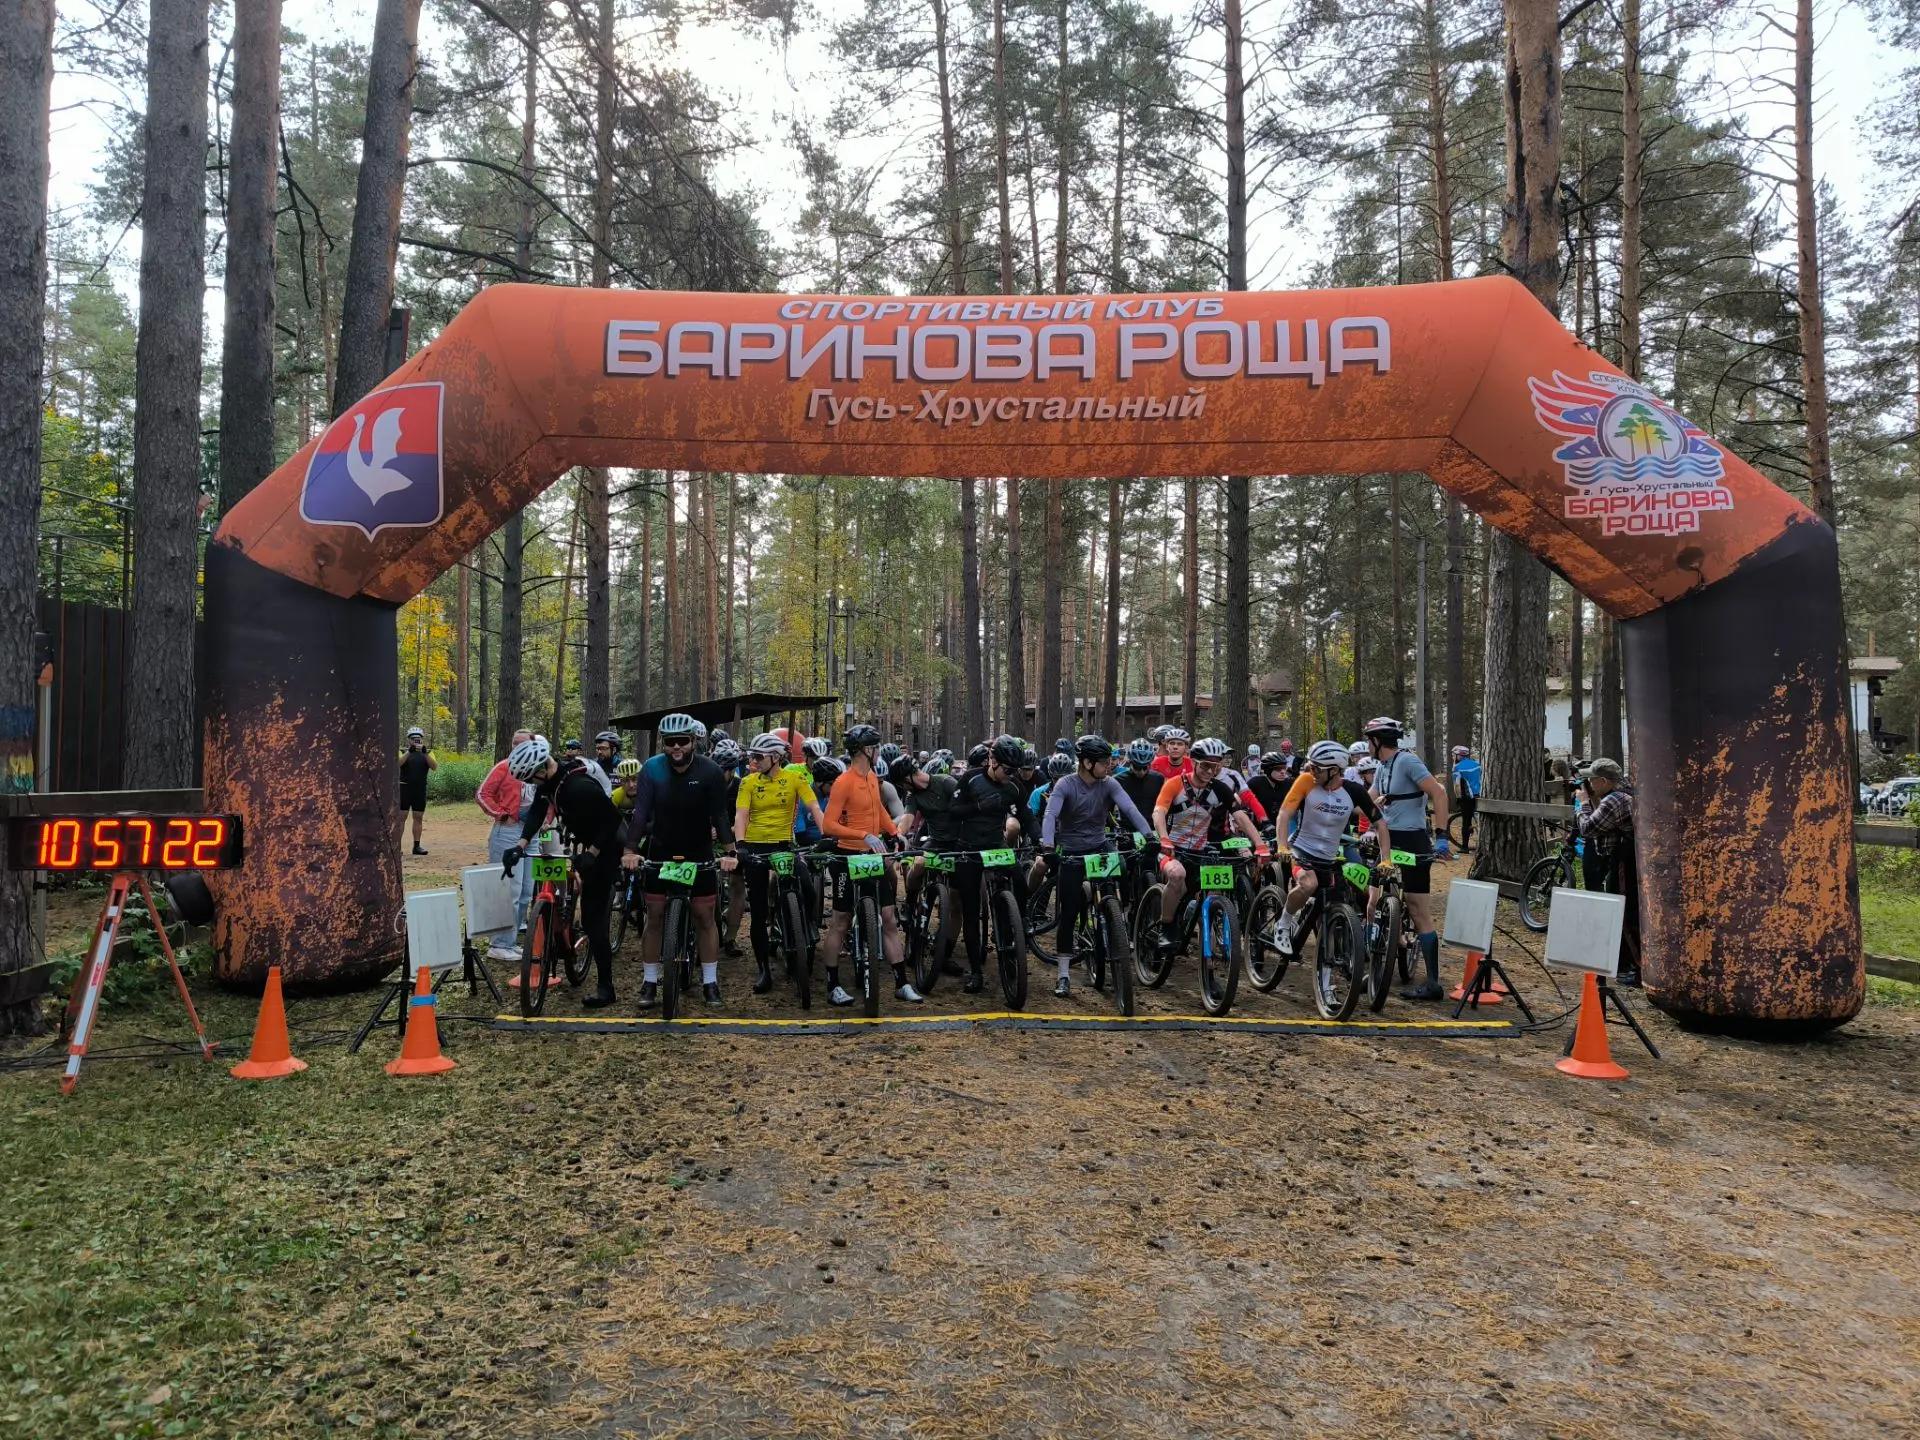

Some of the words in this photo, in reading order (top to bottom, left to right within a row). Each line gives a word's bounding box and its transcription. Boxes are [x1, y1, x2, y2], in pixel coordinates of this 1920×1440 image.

[780, 298, 1095, 321] СПОРТИВНЫЙ
[1105, 298, 1224, 319] КЛУБ
[605, 319, 1097, 381] БАРИНОВА
[1119, 316, 1392, 386] РОЩА
[807, 387, 1207, 426] Гусь-Хрустальный
[1600, 480, 1714, 496] Гусь-Хрустальный
[1569, 489, 1730, 515] БАРИНОВА
[1607, 511, 1695, 533] РОЩА
[535, 864, 564, 877] 199
[1205, 872, 1230, 886] 183
[1346, 866, 1367, 884] 170
